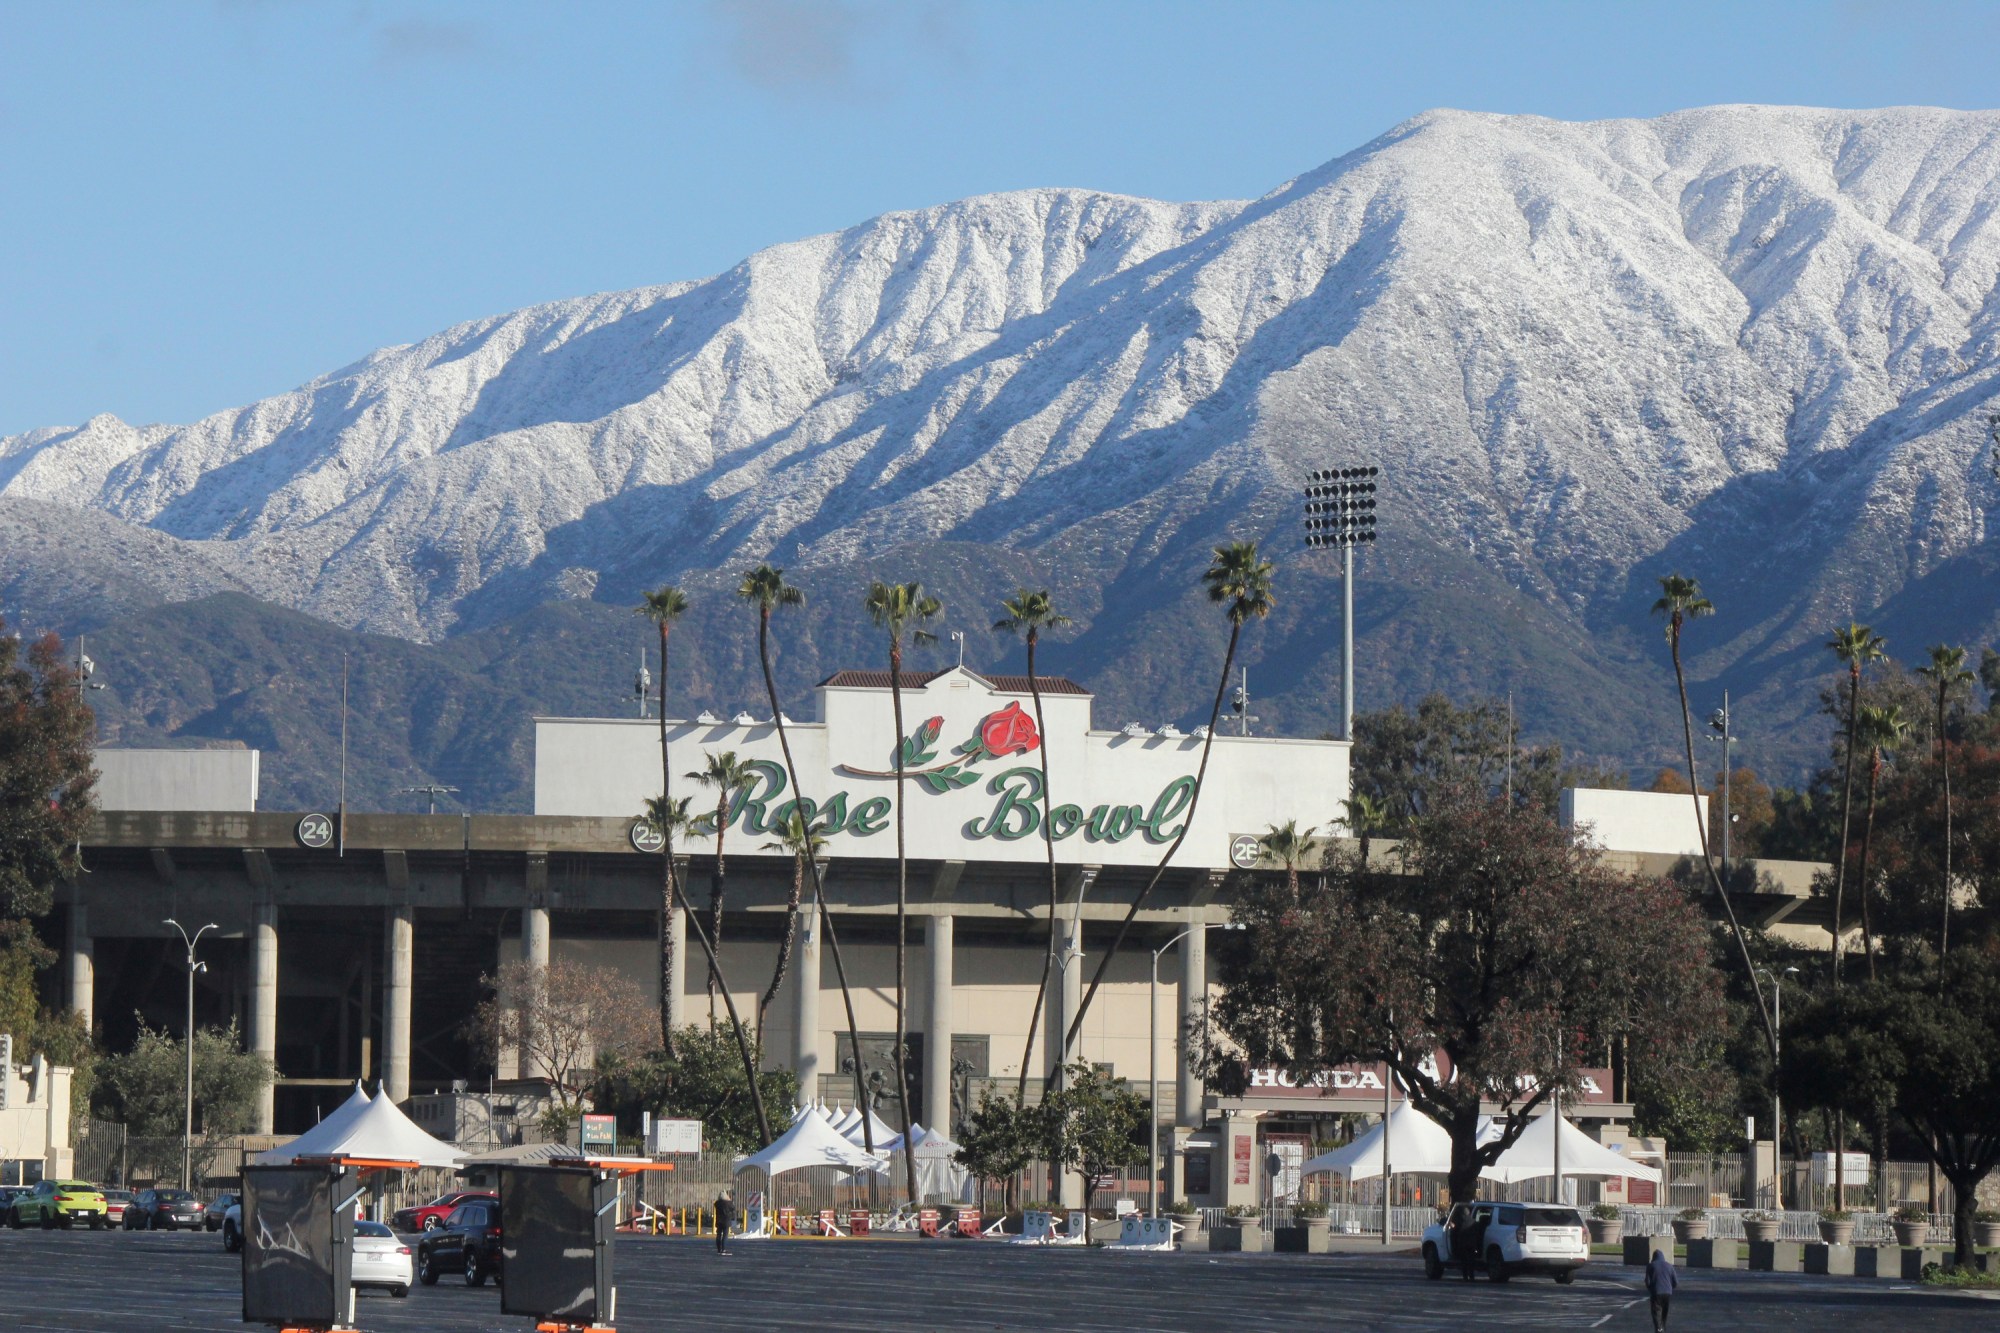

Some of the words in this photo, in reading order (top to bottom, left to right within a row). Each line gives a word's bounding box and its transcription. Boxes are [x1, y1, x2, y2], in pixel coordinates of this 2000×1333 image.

[706, 759, 892, 834] Rose
[969, 766, 1198, 842] Bowl
[304, 822, 329, 839] 24
[637, 826, 662, 843] 25
